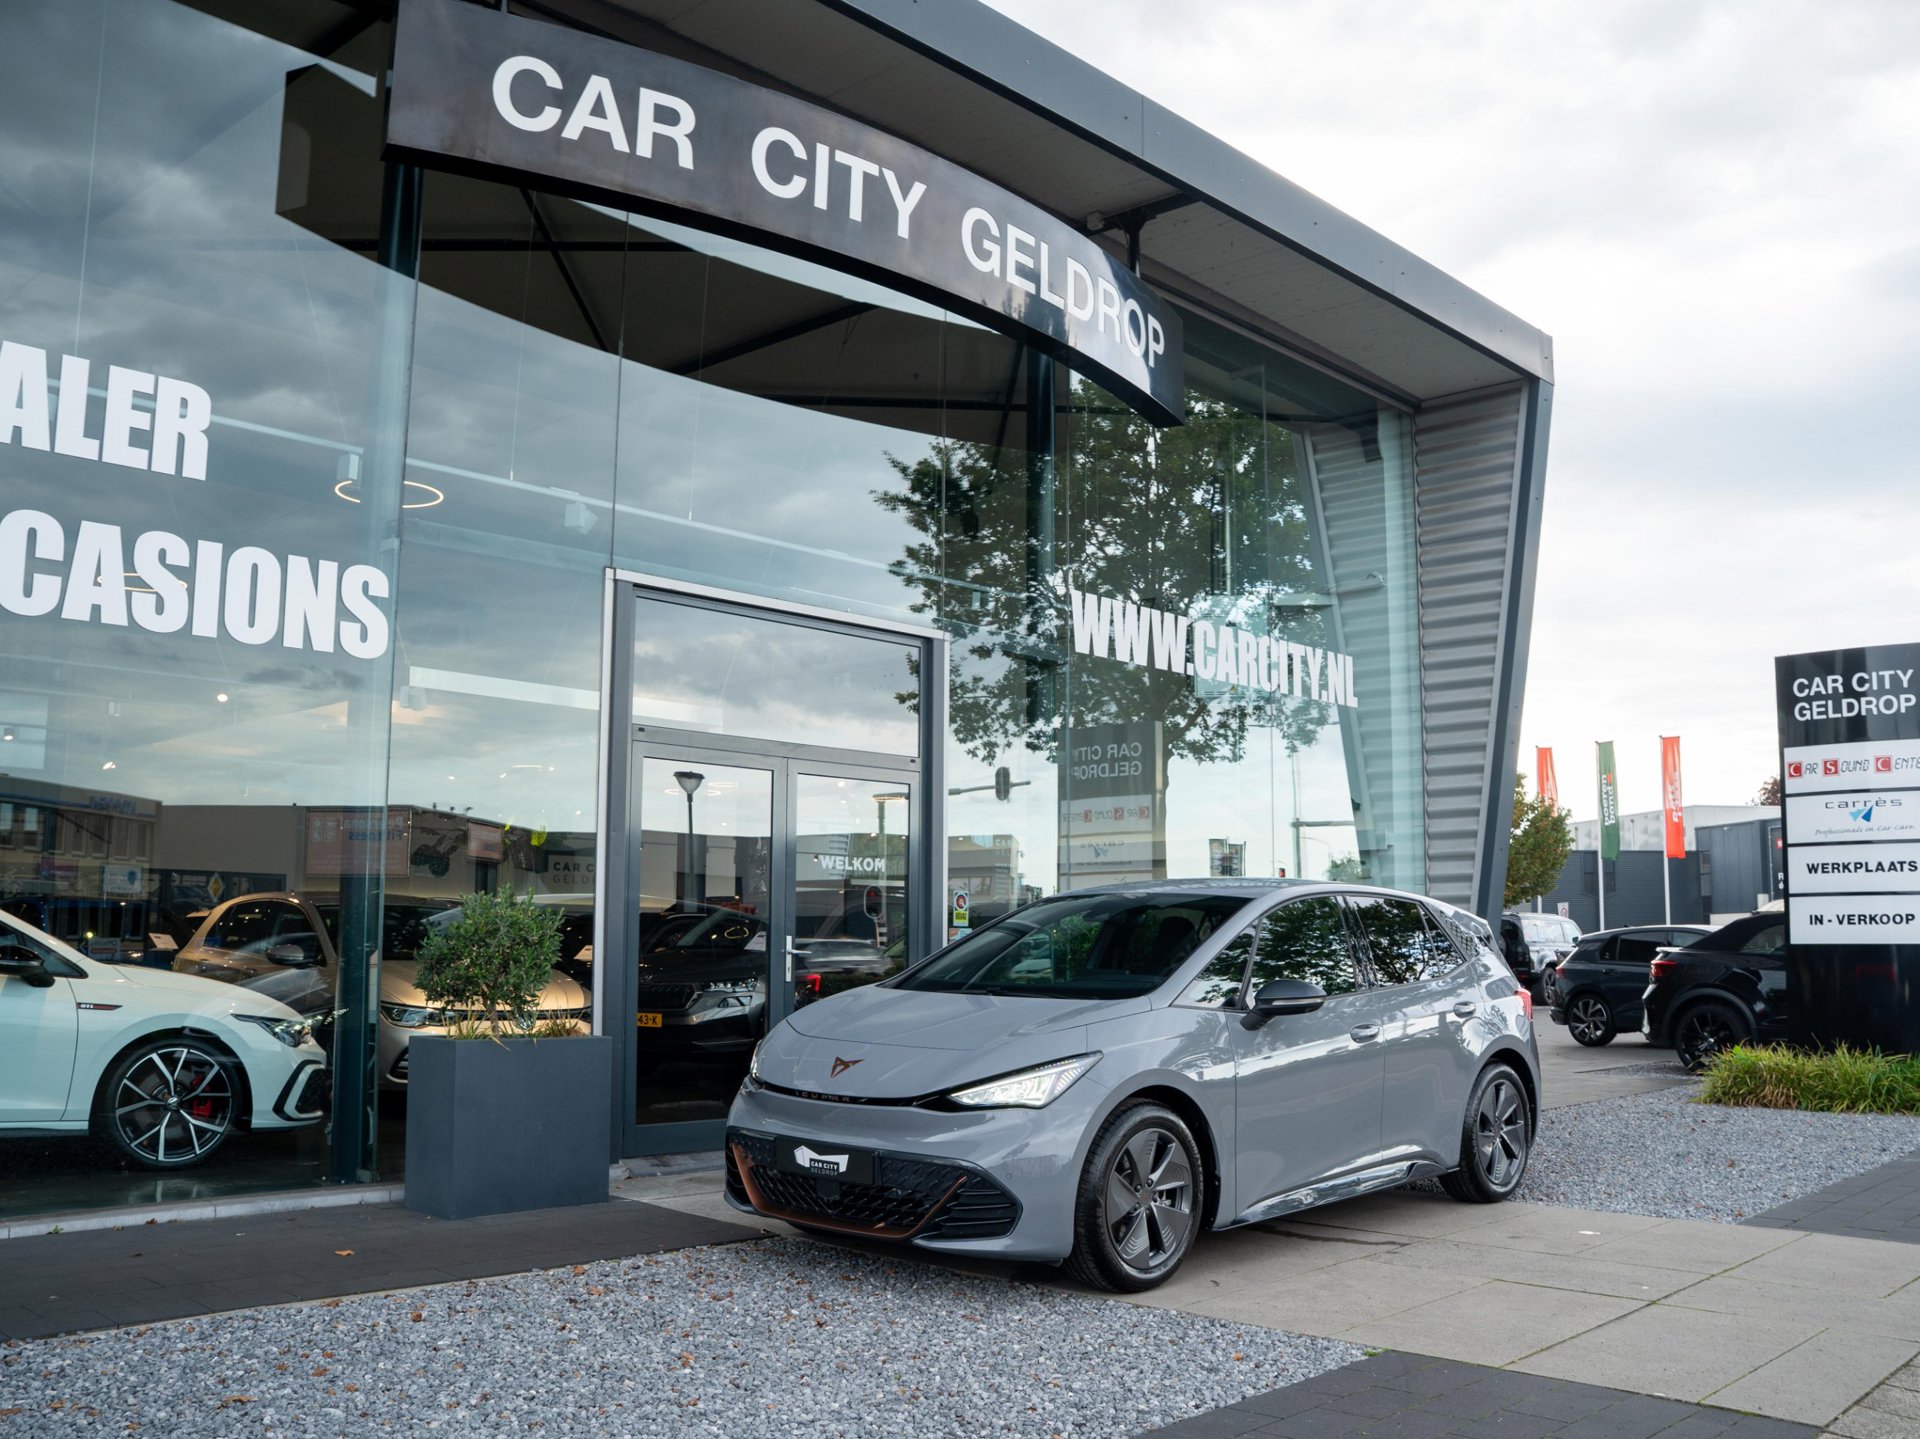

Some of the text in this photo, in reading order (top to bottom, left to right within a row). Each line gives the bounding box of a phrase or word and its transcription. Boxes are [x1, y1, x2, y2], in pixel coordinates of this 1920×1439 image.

[493, 55, 1165, 369] CAR CITY GELDROP
[0, 341, 211, 481] ALER
[0, 510, 389, 659] CASIONS
[1071, 588, 1358, 708] WWW.CARCITY.NL
[1792, 669, 1914, 697] CAR CITY
[1794, 694, 1917, 721] GELDROP
[553, 862, 580, 872] CAR
[818, 854, 886, 872] WELKOM
[1806, 860, 1918, 875] WERKPLAATS
